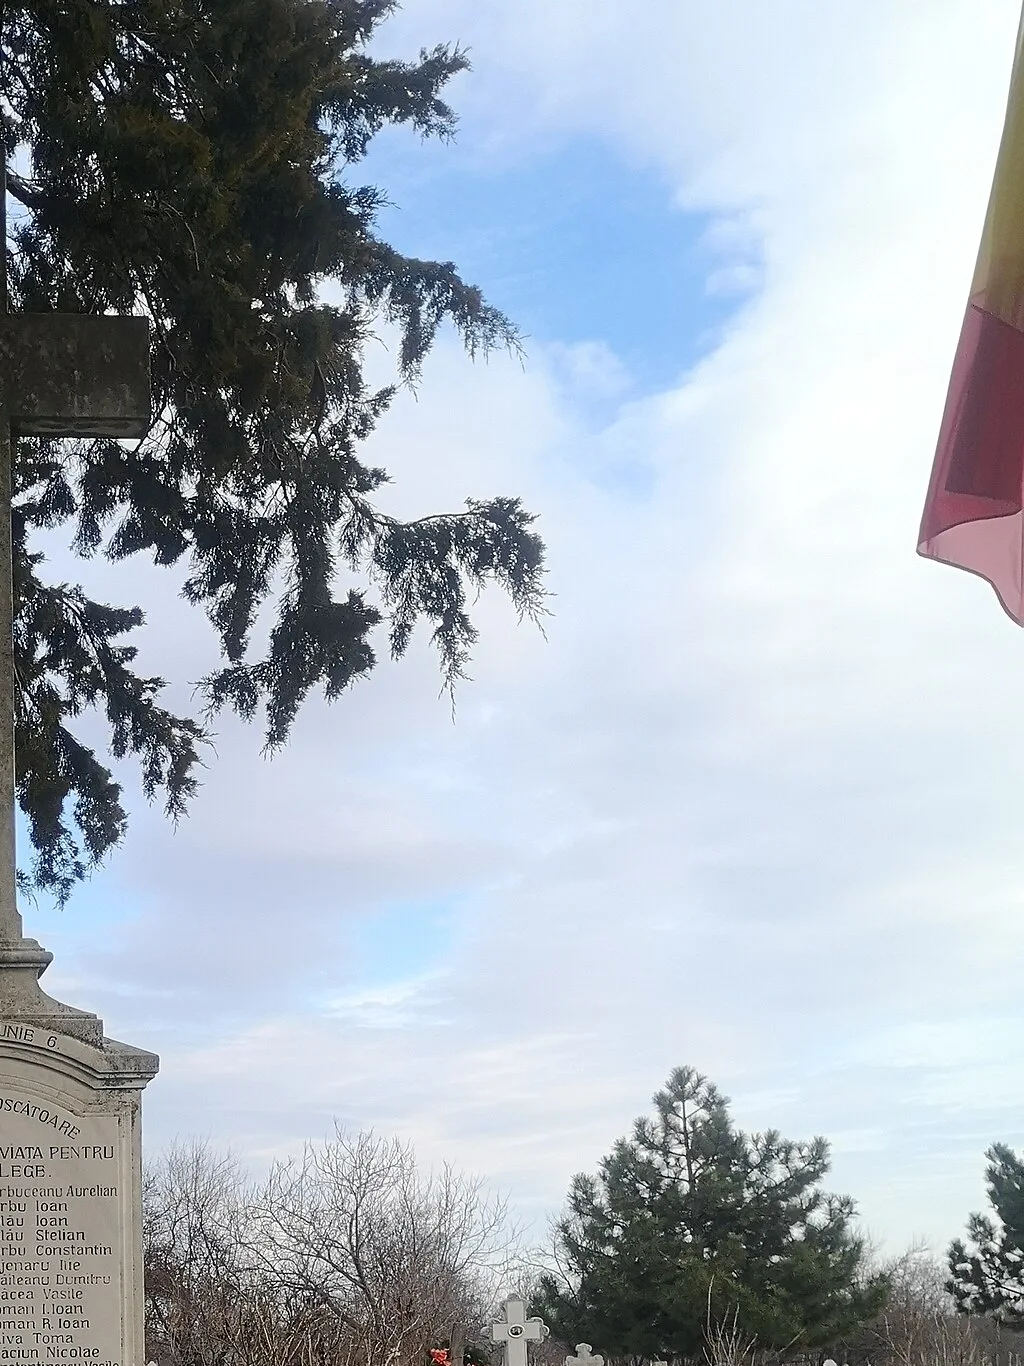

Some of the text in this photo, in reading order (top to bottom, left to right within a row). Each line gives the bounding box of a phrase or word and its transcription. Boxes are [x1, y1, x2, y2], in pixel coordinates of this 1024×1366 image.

[46, 1036, 61, 1050] 6.
[49, 1146, 114, 1160] PENTRU
[66, 1184, 118, 1198] Aurelian
[35, 1200, 68, 1212] Ioan
[36, 1214, 68, 1227] Ioan
[35, 1229, 85, 1241] Stelian
[35, 1243, 113, 1256] Constantin
[59, 1258, 81, 1271] Ilie
[55, 1273, 111, 1285] Dumitru
[42, 1288, 83, 1300] Vasile
[58, 1317, 90, 1329] Ioan
[32, 1332, 74, 1344] Toma
[46, 1346, 100, 1358] Nicolae
